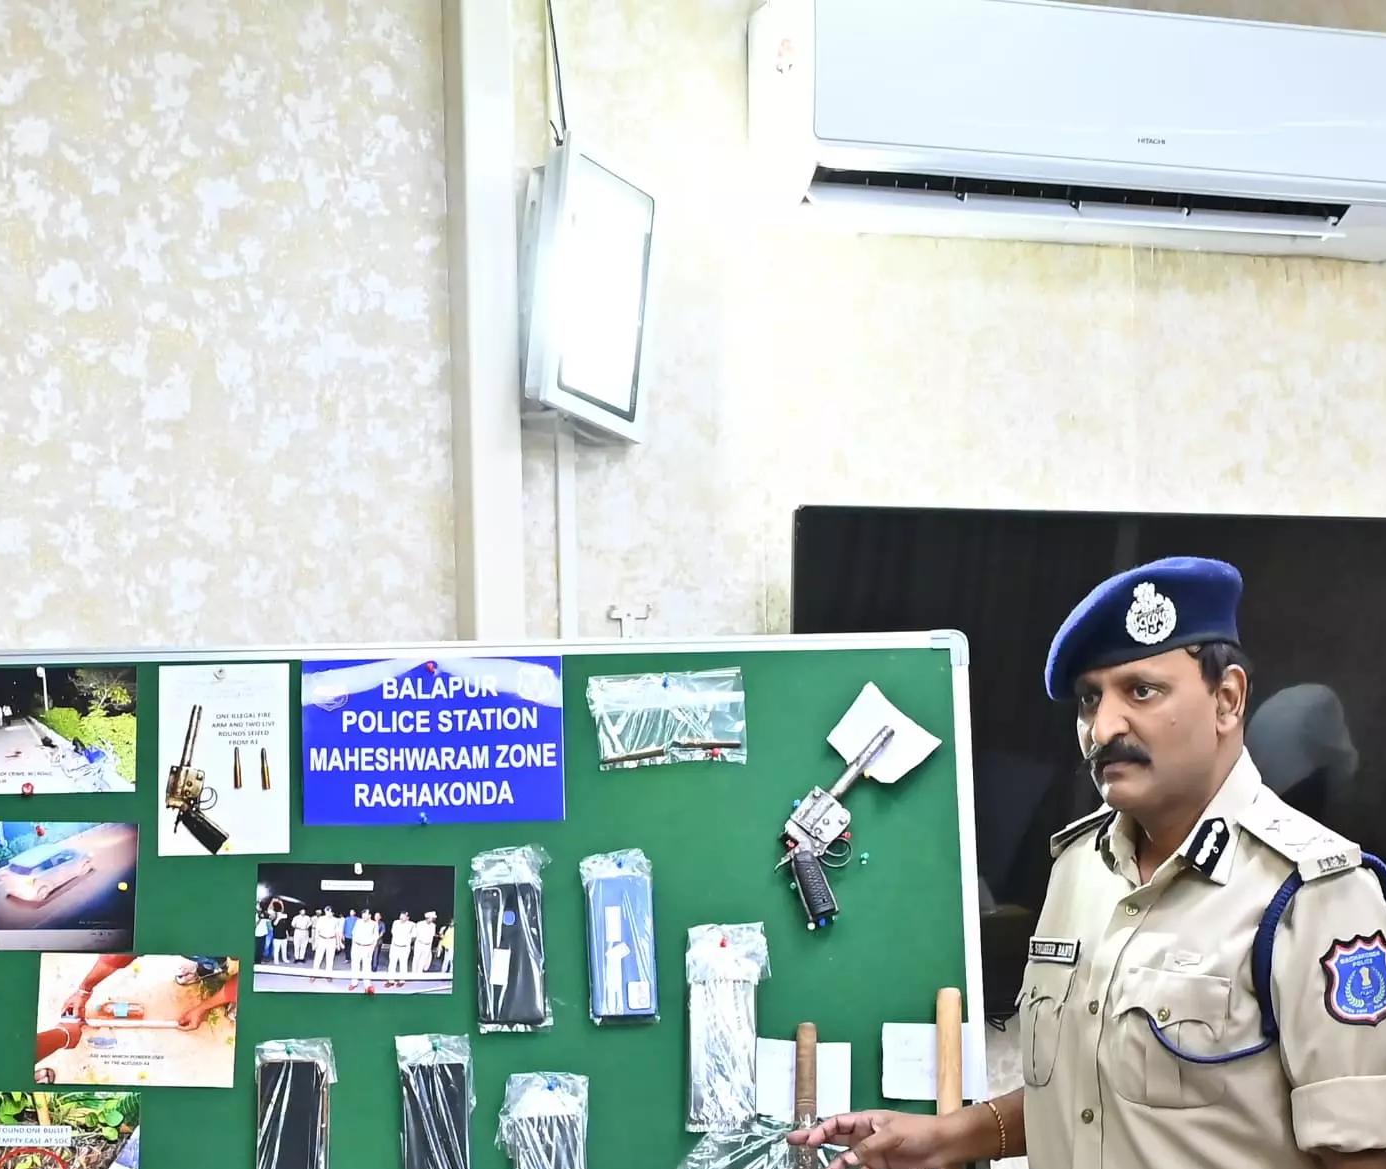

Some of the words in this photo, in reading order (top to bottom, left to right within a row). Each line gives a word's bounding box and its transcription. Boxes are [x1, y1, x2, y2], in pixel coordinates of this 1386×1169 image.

[382, 677, 499, 700] BALAPUR
[342, 709, 431, 733] POLICE
[437, 706, 538, 732] STATION
[309, 744, 490, 771] MAHESHWARAM
[495, 742, 558, 768] ZONE
[354, 780, 515, 807] RACHAKONDA
